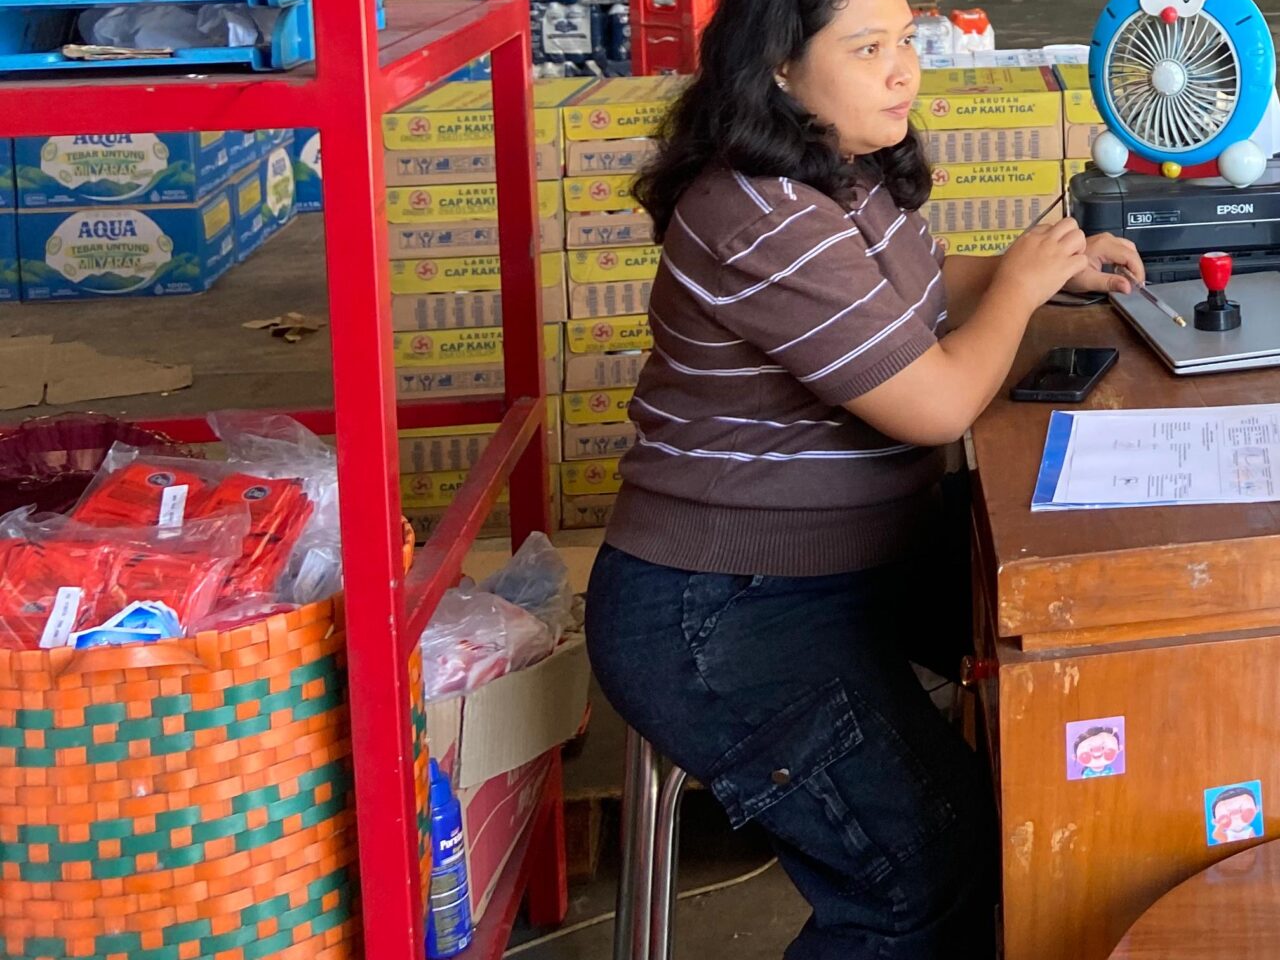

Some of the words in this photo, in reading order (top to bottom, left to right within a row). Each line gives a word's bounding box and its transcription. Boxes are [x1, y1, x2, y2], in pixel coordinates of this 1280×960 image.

[956, 107, 977, 115] CAP
[1009, 105, 1034, 113] TIGA
[457, 114, 493, 122] LARUT
[618, 118, 640, 126] CAP
[438, 125, 461, 134] CAP
[465, 124, 494, 132] KAKI
[67, 151, 98, 161] TEBAR
[102, 149, 144, 160] UNTUNG
[956, 176, 976, 184] CAP
[1008, 173, 1033, 181] TIGA
[439, 199, 463, 207] CAP
[466, 197, 496, 206] KAKI
[1217, 204, 1254, 215] EPSON
[1131, 214, 1152, 223] L310
[78, 220, 137, 240] AQUA
[72, 243, 103, 253] TEBAR
[107, 242, 149, 253] UNTUNG
[625, 258, 647, 266] CAP
[445, 268, 468, 277] CAP
[472, 267, 500, 275] KAKI
[620, 329, 643, 338] CAP
[441, 343, 463, 352] CAP
[467, 341, 496, 350] KAKI
